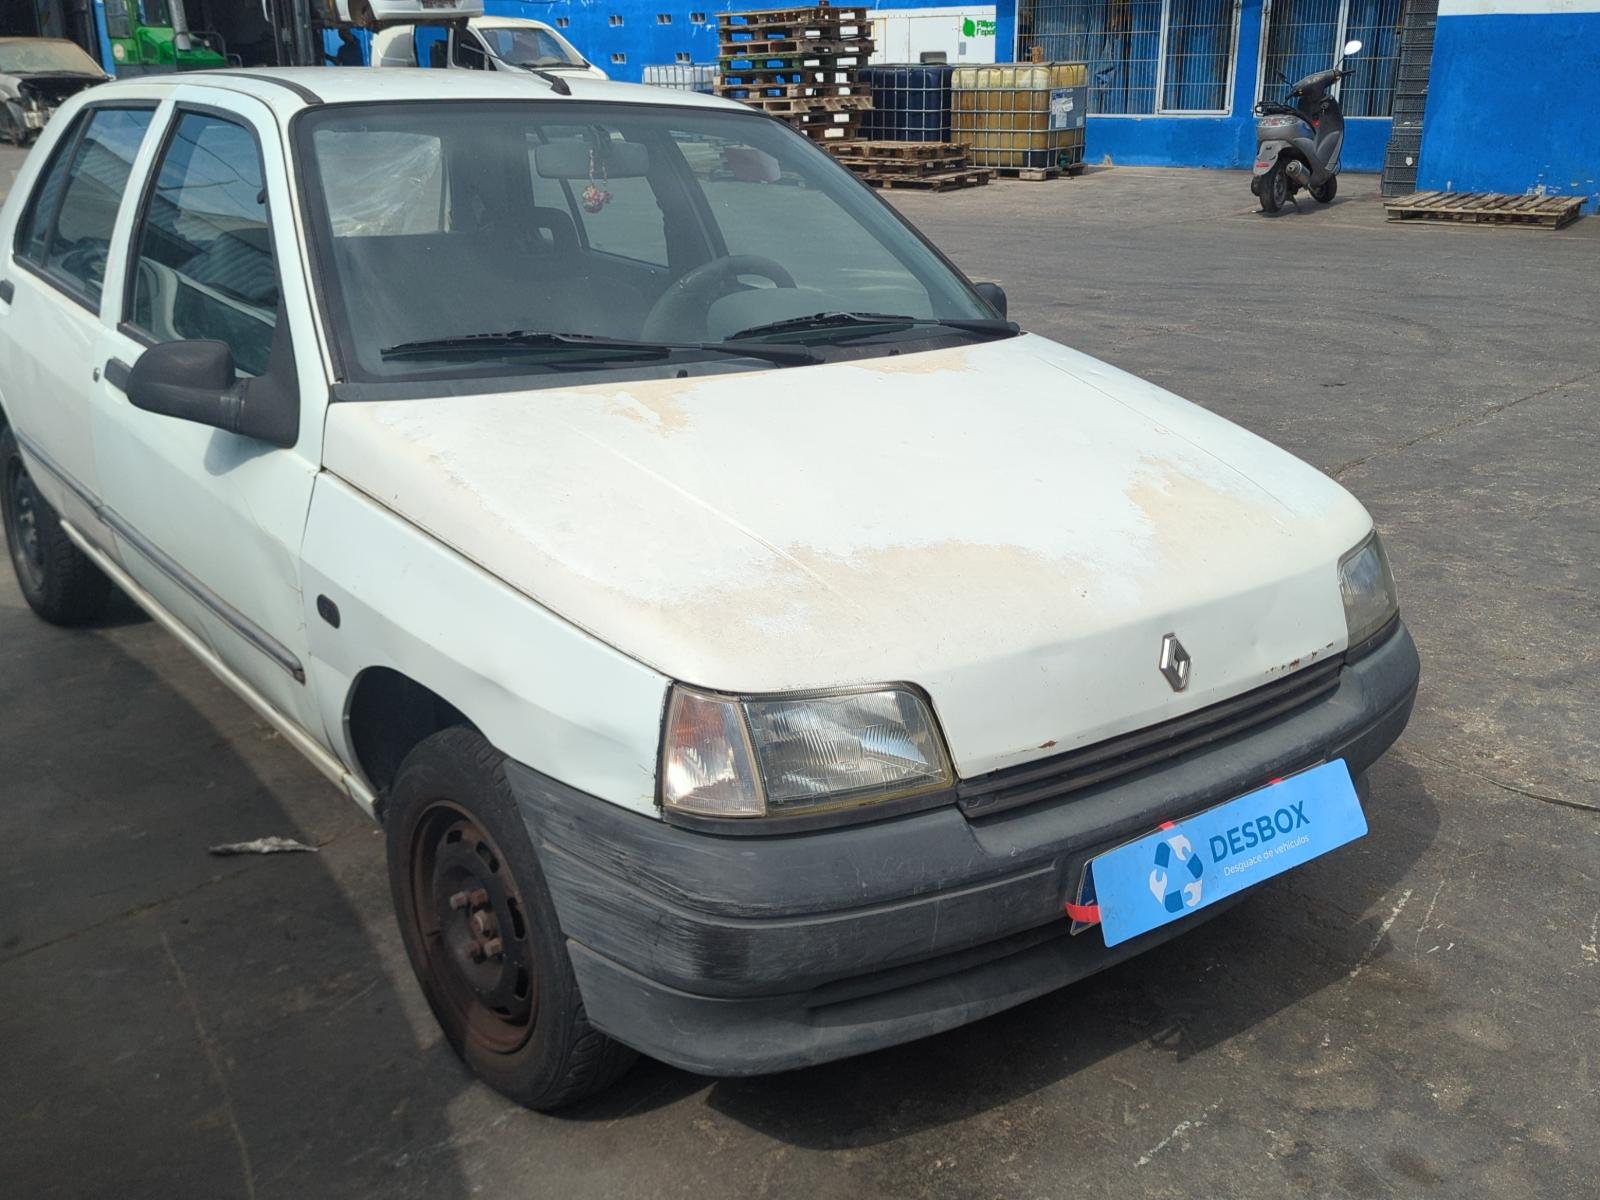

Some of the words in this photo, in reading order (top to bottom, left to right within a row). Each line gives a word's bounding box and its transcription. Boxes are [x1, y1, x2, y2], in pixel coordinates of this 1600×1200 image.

[1209, 800, 1310, 863] DESBOX
[1223, 854, 1263, 876] Desguace
[1263, 848, 1274, 860] de
